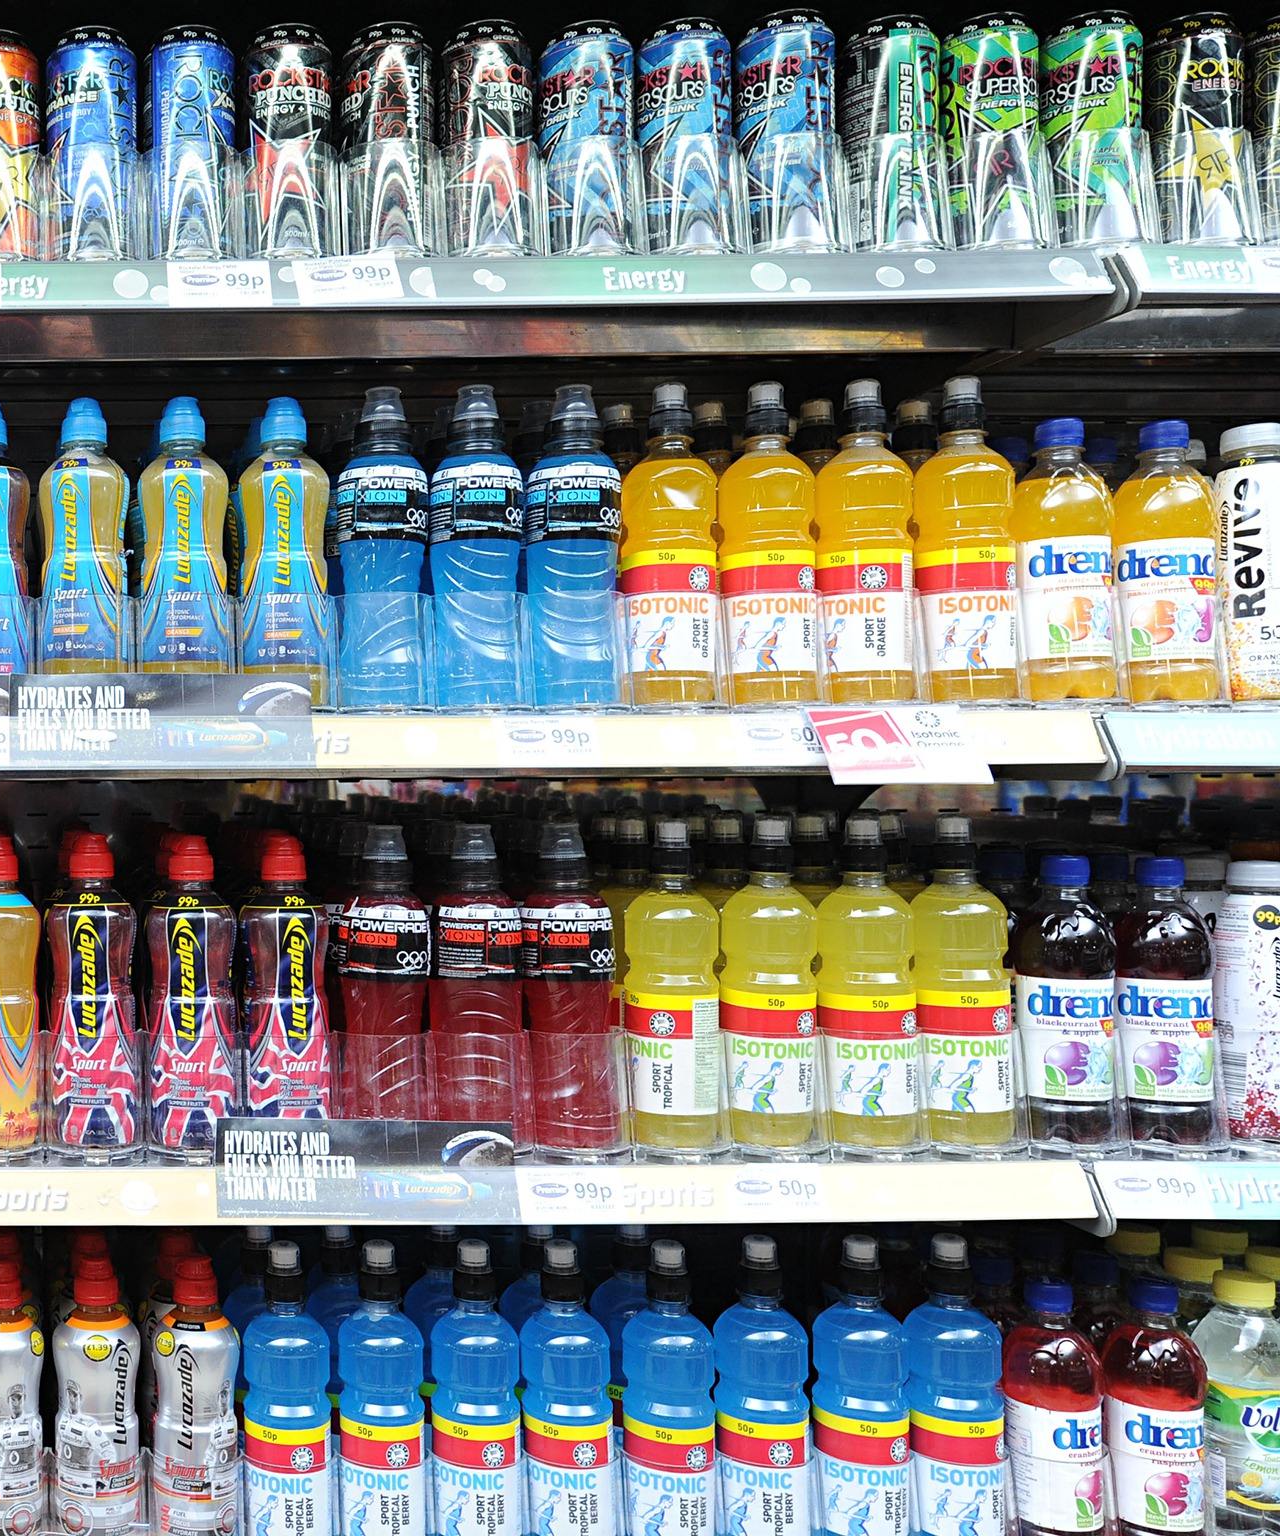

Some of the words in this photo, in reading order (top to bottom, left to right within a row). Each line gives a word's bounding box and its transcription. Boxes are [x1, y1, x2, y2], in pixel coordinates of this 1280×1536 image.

[1193, 79, 1242, 92] ENERGY
[254, 86, 331, 107] PUNCHED
[406, 64, 420, 129] PUNCH
[749, 99, 787, 115] DRINK
[256, 105, 296, 119] ENERGY
[548, 109, 581, 127] DRINK
[1065, 97, 1109, 118] DRINK
[352, 266, 391, 281] 99p
[603, 267, 685, 291] Energy
[1167, 255, 1251, 283] Energy
[225, 273, 264, 289] 99p
[60, 484, 77, 583] Lucozade
[173, 490, 191, 584] Lucozade
[273, 490, 291, 586] Lucozade
[1219, 510, 1229, 562] Lucozade
[658, 552, 676, 562] 50p
[768, 553, 786, 562] 50p
[830, 554, 846, 564] 50p
[979, 550, 996, 560] 50p
[1233, 478, 1266, 619] Revive
[265, 592, 303, 604] Sport
[692, 617, 701, 649] SPORT
[702, 618, 710, 659] ORANGE
[865, 617, 874, 649] SPORT
[876, 617, 886, 657] ORANGE
[18, 686, 88, 709] HYDRATES
[92, 686, 125, 709] AND
[18, 709, 56, 730] FUELS
[60, 709, 92, 730] YOU
[94, 709, 150, 730] BETTER
[18, 730, 57, 750] THAN
[551, 729, 590, 746] 99p
[910, 730, 960, 740] Isotonic
[439, 921, 485, 931] POWERADE
[768, 998, 786, 1008] 50p
[1036, 1018, 1098, 1028] blackcurrant
[1125, 1018, 1189, 1028] blackcurrant
[653, 1062, 662, 1093] SPORT
[663, 1063, 673, 1110] TROPICAL
[798, 1062, 806, 1093] SPORT
[906, 1062, 914, 1094] SPORT
[224, 1130, 298, 1155] HYDRATES
[301, 1131, 330, 1155] AND
[224, 1155, 267, 1178] FUELS
[270, 1155, 299, 1178] YOU
[300, 1156, 356, 1179] BETTER
[224, 1177, 266, 1201] THAN
[268, 1178, 317, 1201] WATER
[532, 1185, 567, 1196] Premier
[574, 1182, 612, 1201] 99p
[779, 1179, 816, 1198] 50p
[1157, 1178, 1196, 1197] 99p
[1140, 1447, 1188, 1459] cranberry
[825, 1462, 908, 1483] ISOTONIC
[1243, 1458, 1279, 1475] Lemon
[285, 1497, 294, 1529] SPORT
[306, 1497, 314, 1528] BERRY
[402, 1493, 410, 1525] BERRY
[786, 1492, 794, 1524] BERRY
